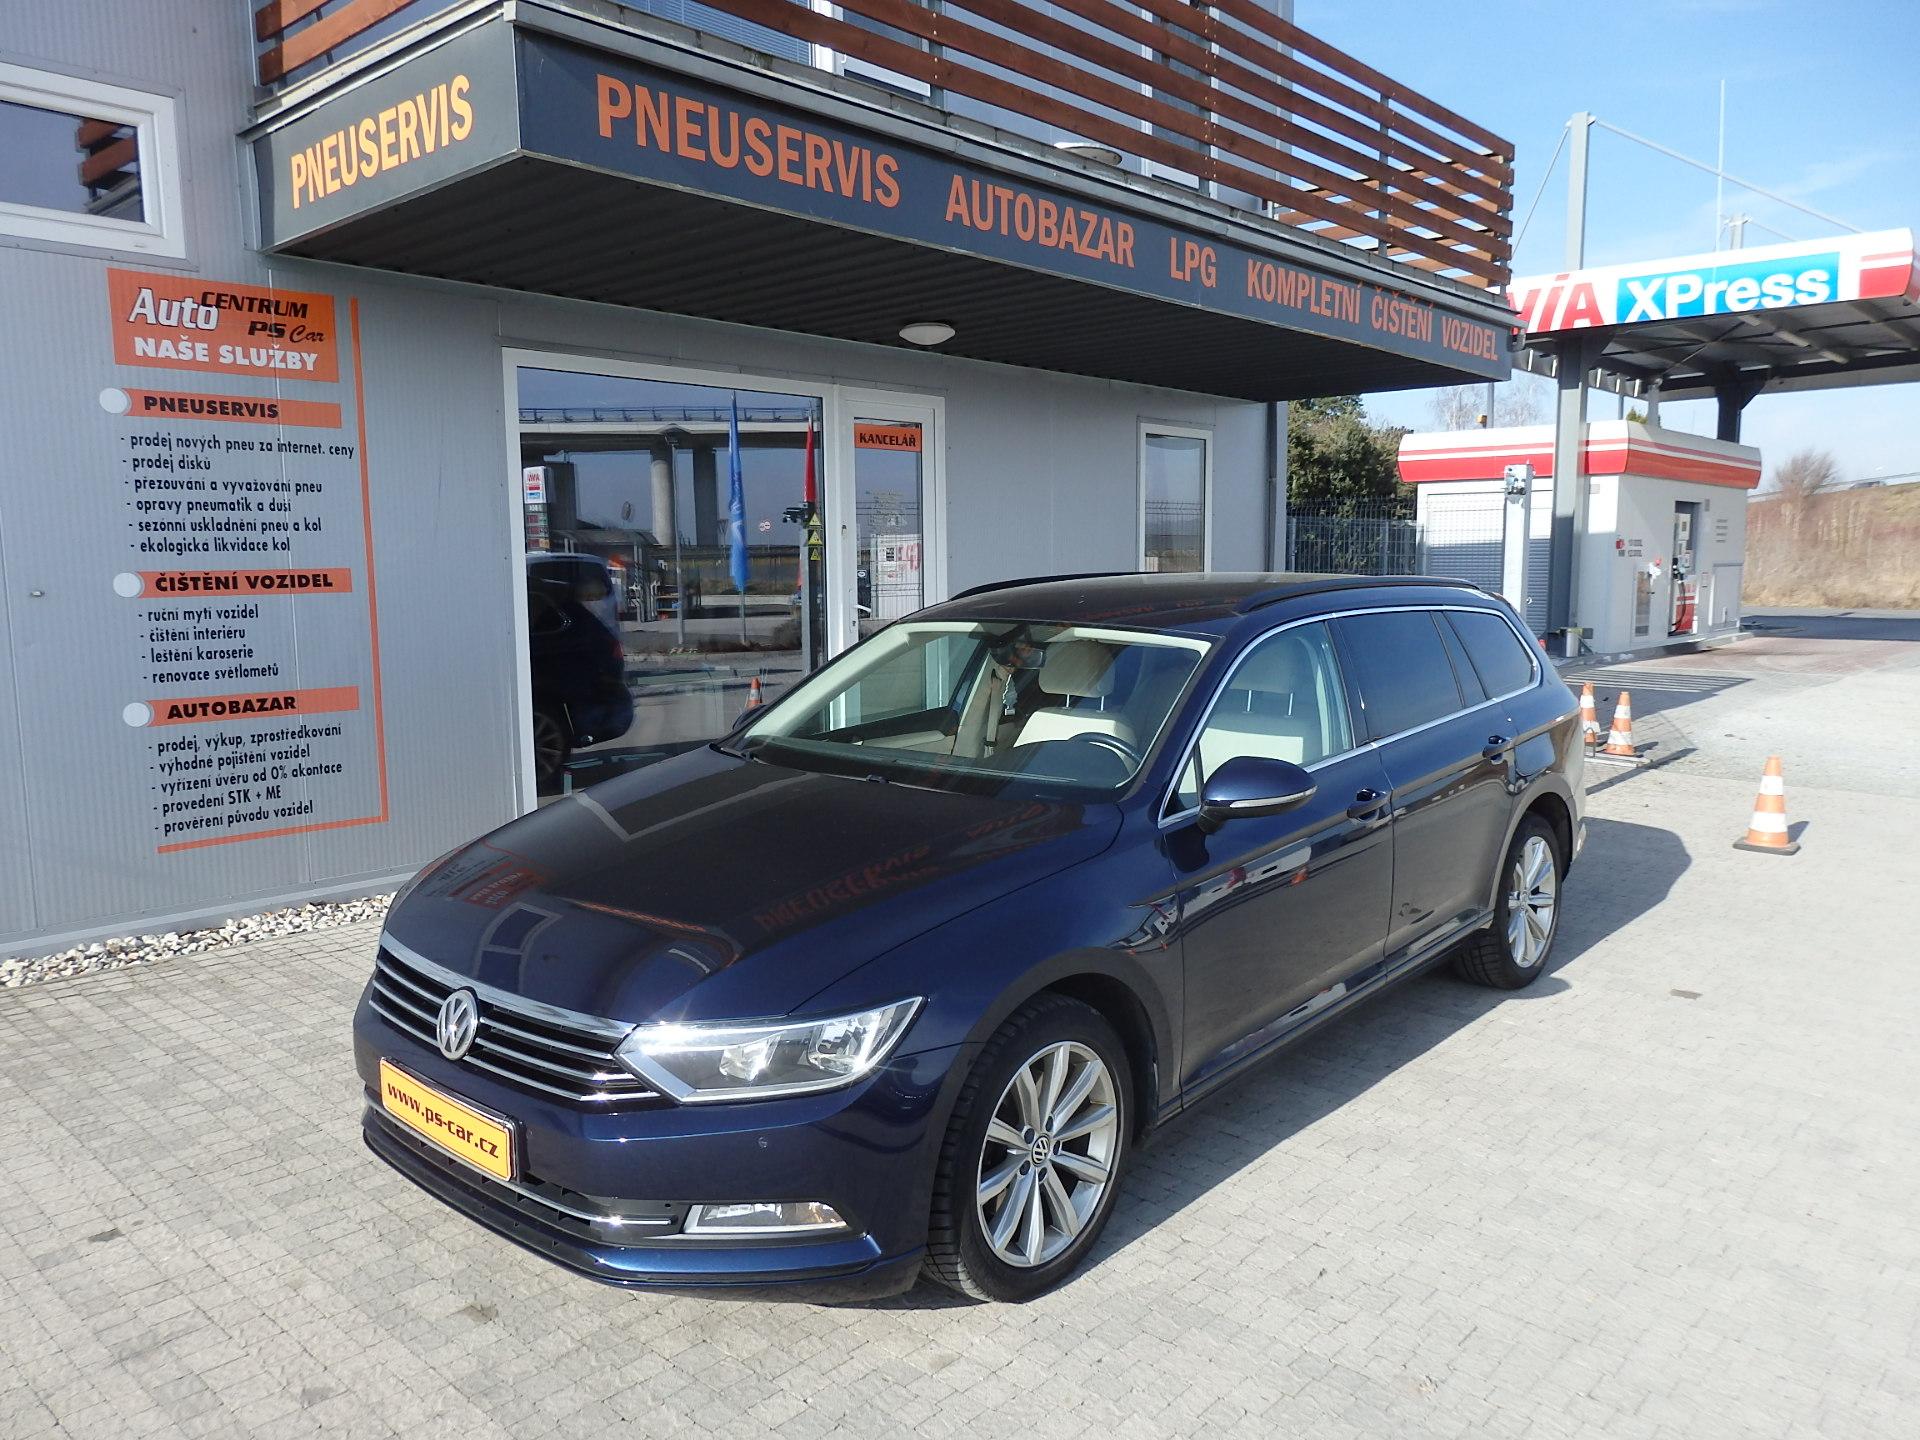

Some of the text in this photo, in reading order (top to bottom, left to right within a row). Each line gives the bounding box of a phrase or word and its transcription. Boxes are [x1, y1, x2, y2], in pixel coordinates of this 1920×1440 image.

[290, 74, 474, 209] PNEUSERVIS
[596, 73, 1498, 361] PNEUSERVIS AUTOBAZAR LPG KOMPLETNÍ ČIŠTĚNÍ VOZIDEL
[1624, 269, 1830, 324] XPress
[127, 286, 308, 331] Auto CENTRUM
[248, 320, 325, 343] PS Car
[134, 335, 318, 371] NAŠE SLUŽBY
[144, 395, 279, 418] PNEUSERVIS
[131, 432, 172, 451] prodej
[176, 434, 221, 452] nových
[226, 440, 255, 453] pneu
[260, 442, 273, 451] za
[329, 445, 354, 459] ceny
[859, 432, 916, 447] KANCELÁŘ
[132, 453, 174, 473] prodej
[210, 481, 217, 490] a
[295, 483, 322, 496] pneu
[136, 500, 181, 514] opravy
[187, 497, 252, 514] pneumatik
[257, 502, 264, 511] a
[261, 521, 289, 534] pneu
[293, 522, 300, 531] a
[304, 517, 322, 531] kol
[140, 536, 291, 556] ekologická likvidace kol
[155, 572, 333, 592] ČIŠTĚNÍ VOZIDEL
[216, 603, 259, 619] vozidel
[196, 644, 254, 661] karoserie
[152, 670, 210, 683] renovace
[167, 696, 297, 720] AUTOBAZAR
[159, 754, 213, 776] výhodné
[270, 743, 311, 760] vozidel
[252, 767, 267, 782] od
[270, 764, 288, 780] 0%
[291, 762, 343, 778] akontace
[228, 788, 252, 805] STK
[255, 791, 262, 800] +
[266, 784, 282, 800] ME
[273, 799, 314, 818] vozidel
[387, 1082, 499, 1159] www.ps-car.cz
